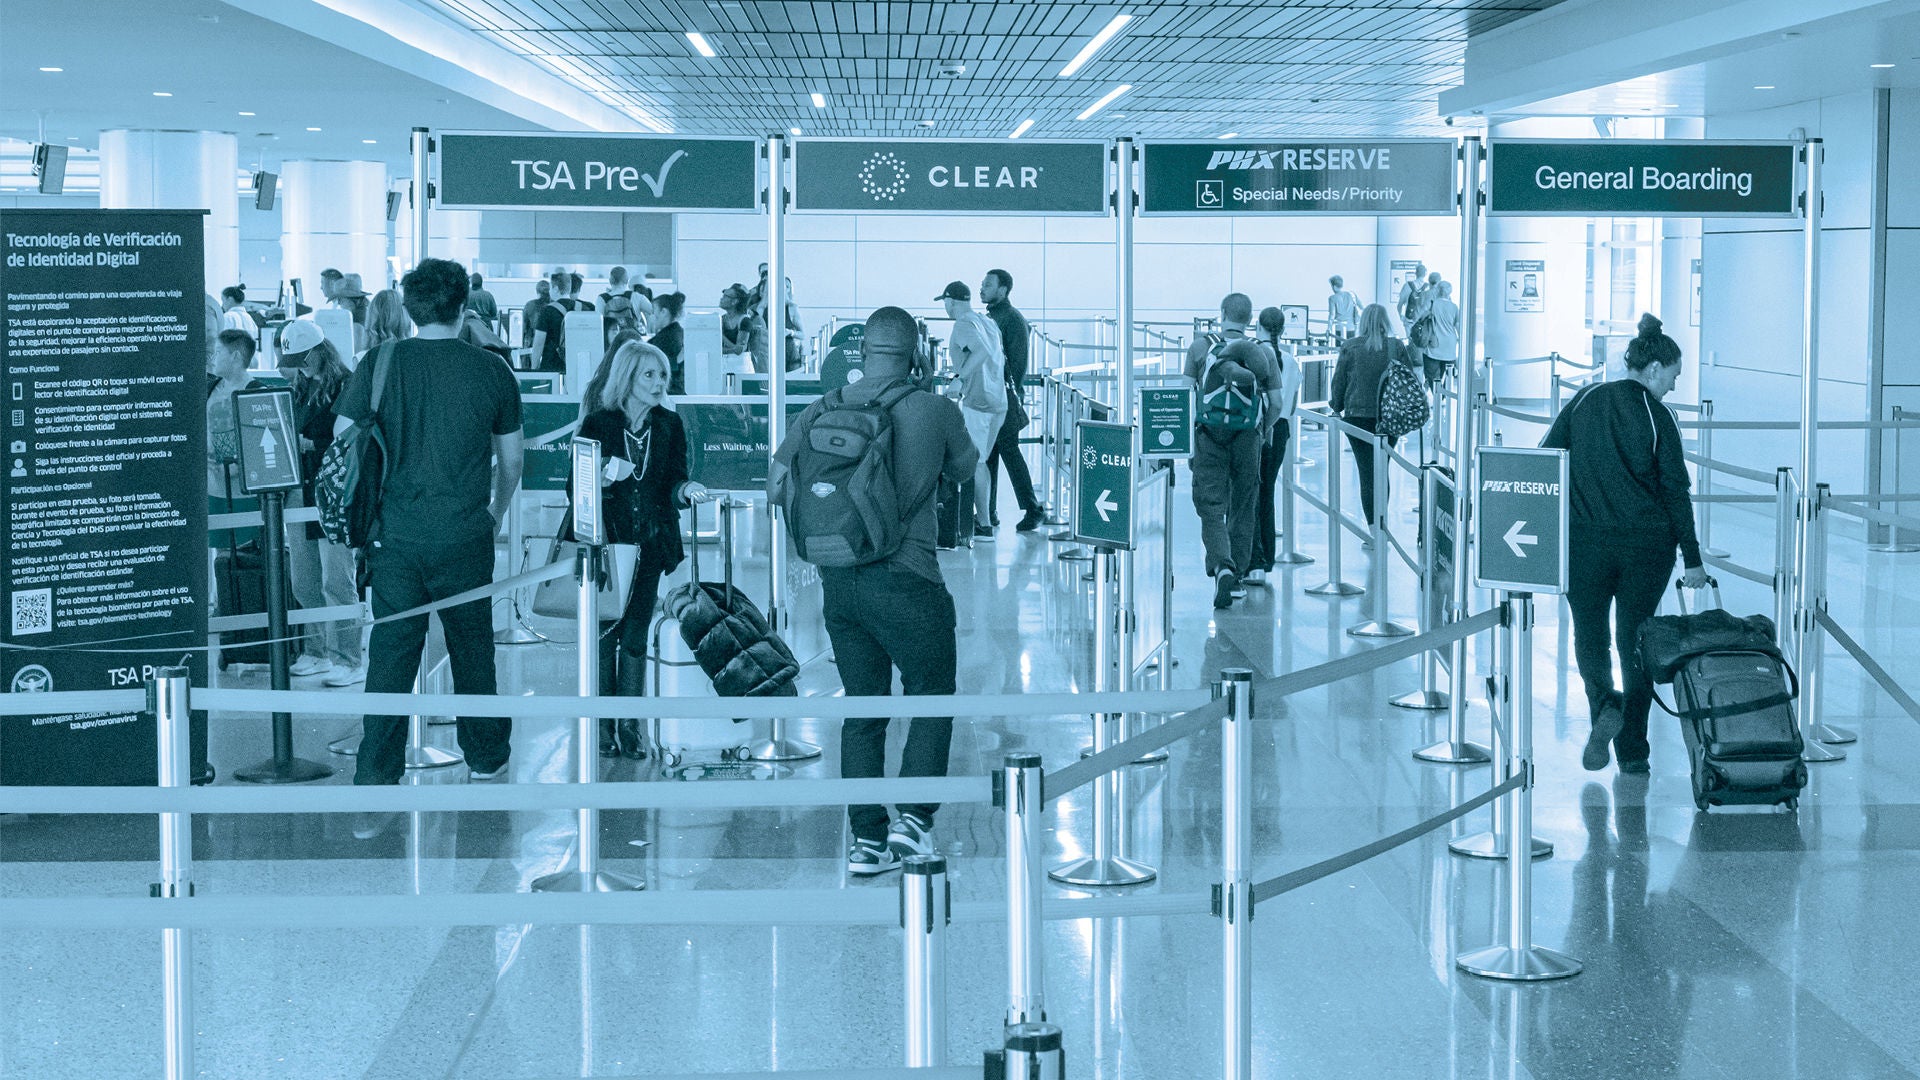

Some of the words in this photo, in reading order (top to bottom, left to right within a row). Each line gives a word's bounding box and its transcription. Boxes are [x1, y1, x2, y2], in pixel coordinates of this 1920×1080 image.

[1206, 150, 1283, 170] PHX
[1283, 149, 1390, 170] RESERVE
[511, 160, 576, 190] TSA
[584, 162, 639, 191] Pre
[928, 166, 1038, 188] CLEAR
[1534, 166, 1633, 190] General
[1642, 167, 1752, 197] Boarding
[1232, 187, 1288, 203] Special
[7, 232, 80, 249] Tecnología
[83, 232, 100, 247] de
[103, 232, 182, 247] Verificación
[7, 253, 25, 267] de
[28, 252, 93, 267] Identidad
[97, 252, 140, 268] Digital
[703, 443, 721, 451] Less
[722, 443, 754, 453] Waiting,
[1482, 481, 1513, 492] PHX
[1513, 482, 1559, 496] RESERVE
[107, 666, 139, 686] TSA
[70, 715, 137, 730] tsa.gov/coronavirus
